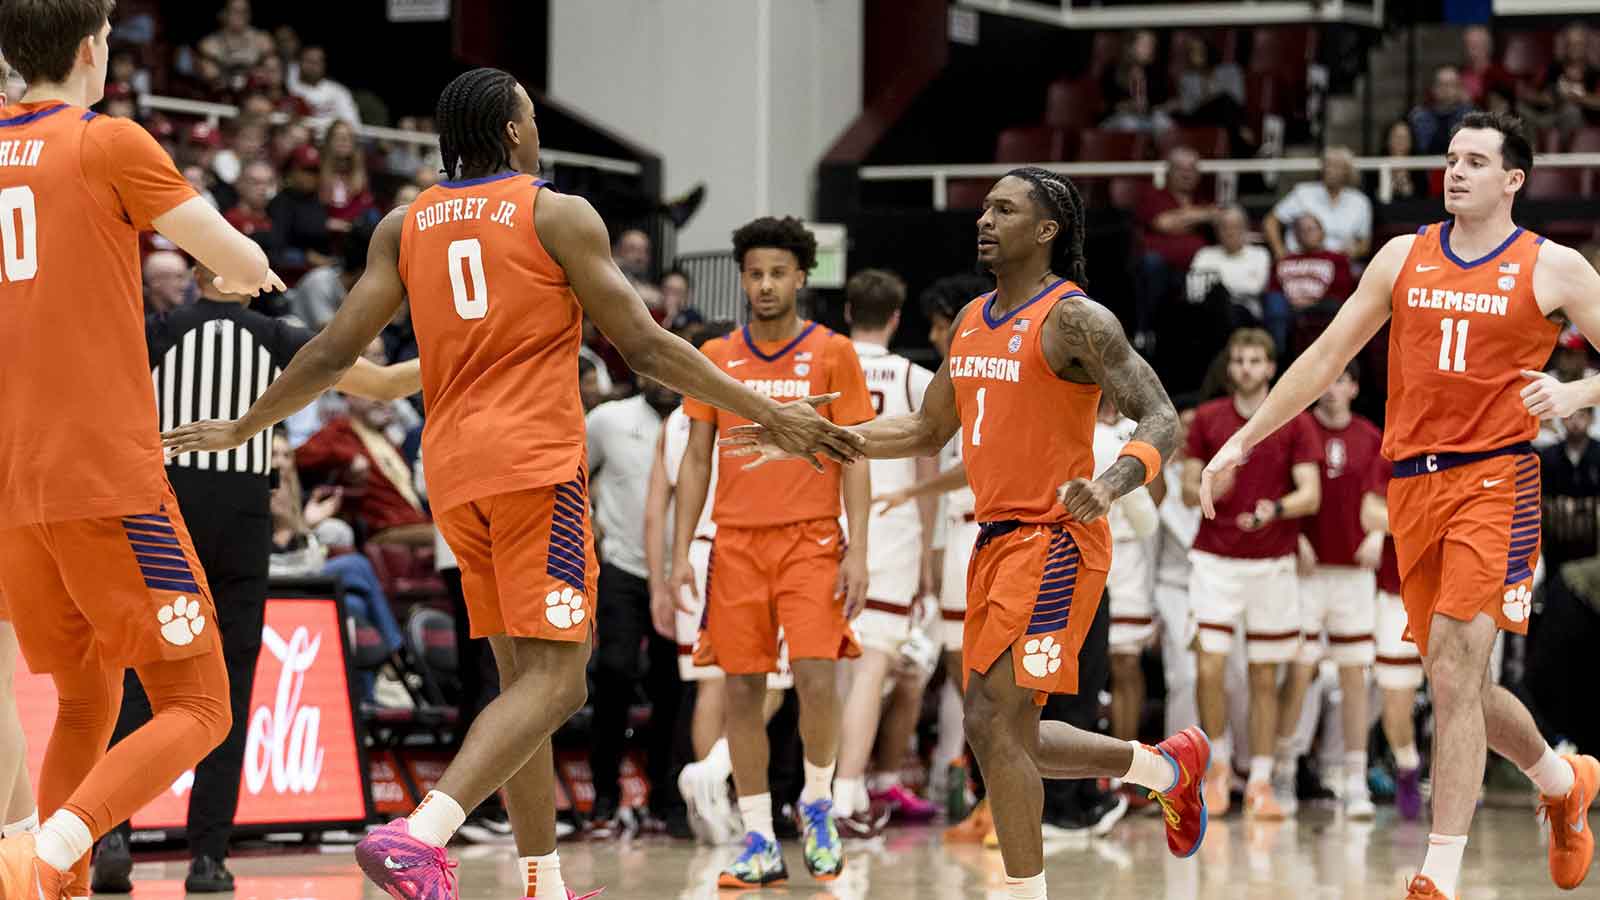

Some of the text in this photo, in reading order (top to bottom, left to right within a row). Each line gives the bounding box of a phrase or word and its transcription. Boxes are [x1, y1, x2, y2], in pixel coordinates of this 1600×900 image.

[0, 185, 38, 282] 0
[416, 198, 517, 231] GODFREY JR.
[447, 238, 489, 320] 0
[1407, 287, 1509, 316] CLEMSON
[1438, 317, 1470, 373] 11
[744, 380, 811, 398] EMSON
[949, 356, 1021, 383] CLEMSON
[971, 387, 986, 446] 1
[1426, 454, 1438, 472] C
[244, 625, 325, 794] ola
